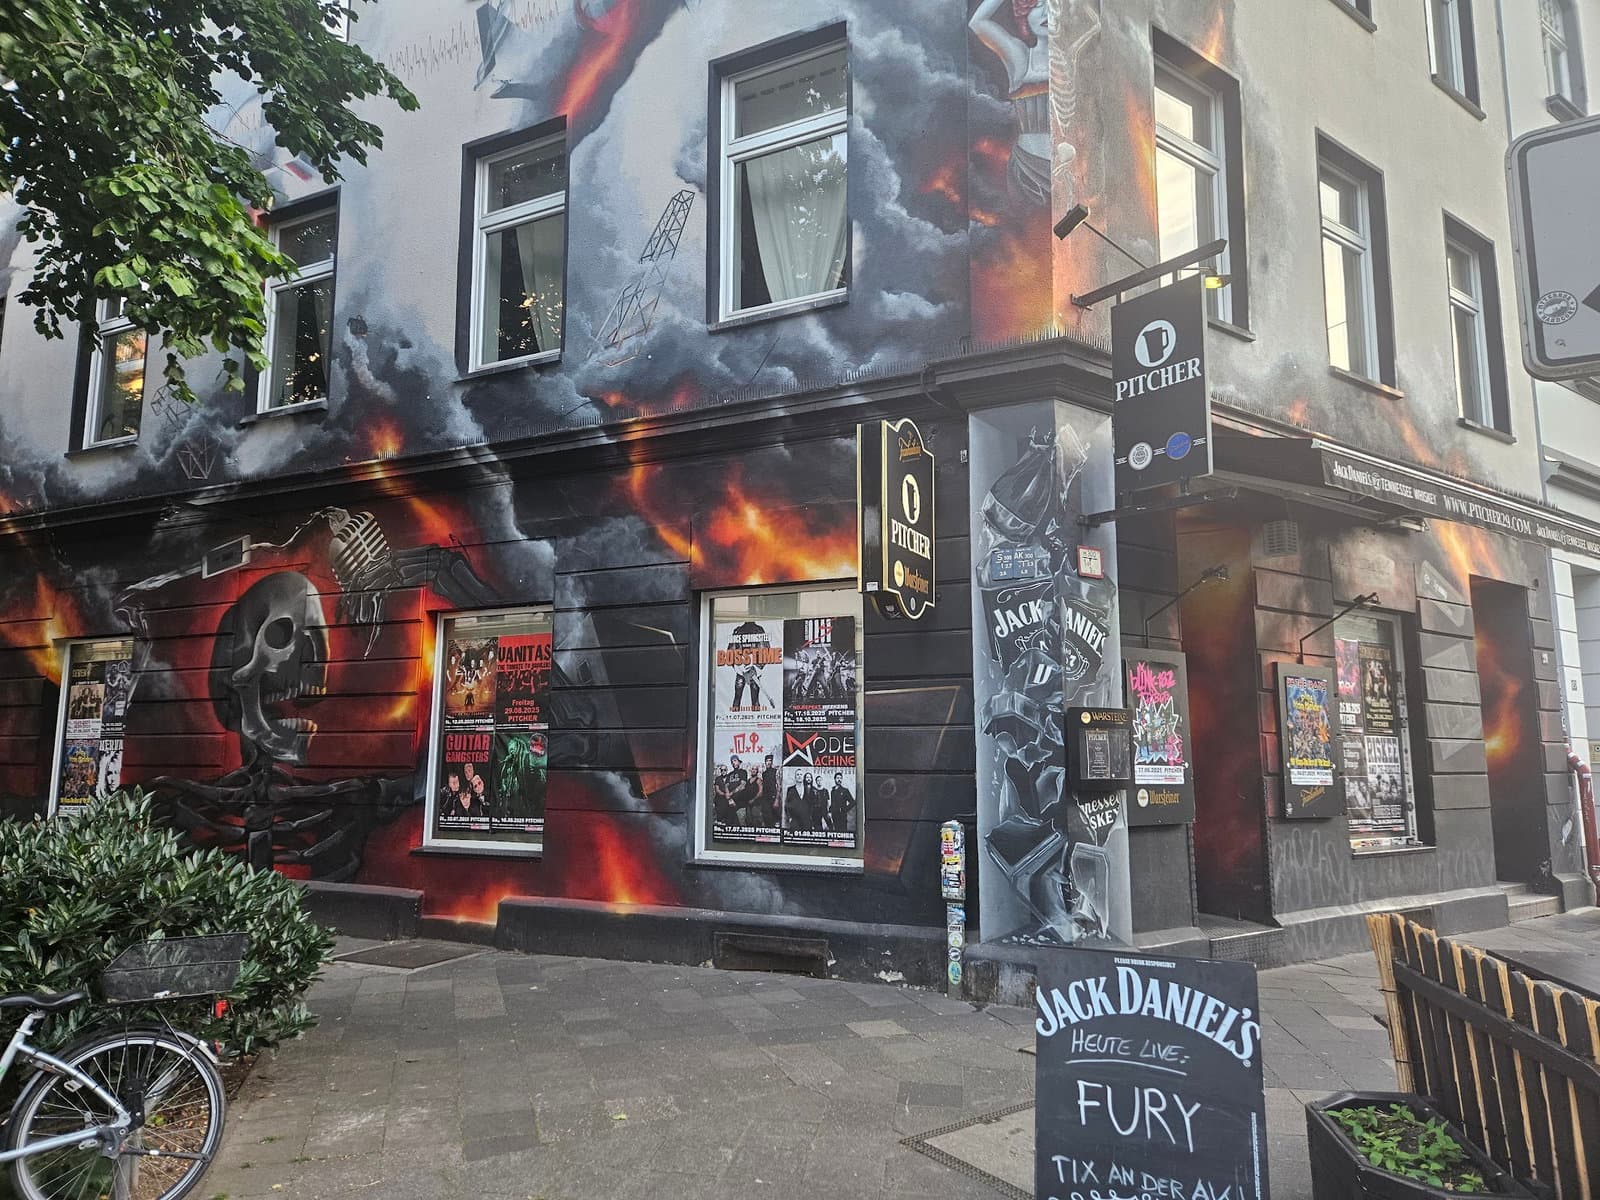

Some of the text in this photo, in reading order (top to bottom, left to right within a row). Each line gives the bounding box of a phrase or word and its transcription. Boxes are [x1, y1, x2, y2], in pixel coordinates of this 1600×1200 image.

[1115, 357, 1202, 402] PITCHER
[891, 518, 931, 560] PITCHER
[997, 553, 1003, 561] S
[1014, 552, 1024, 560] AK
[993, 599, 1042, 638] JACK
[717, 647, 782, 667] BOSSTIME
[504, 706, 539, 714] 29.08.2025
[446, 734, 491, 751] GUITAR
[445, 751, 490, 763] GANGSTERS
[1149, 788, 1180, 805] Warsteiner
[1036, 966, 1260, 1060] JACK DANIEL'S
[1072, 1028, 1132, 1055] HEUTE
[1077, 1080, 1201, 1153] FURY
[1052, 1155, 1100, 1184] TIX
[1109, 1160, 1134, 1187] AN
[1140, 1171, 1185, 1200] DER
